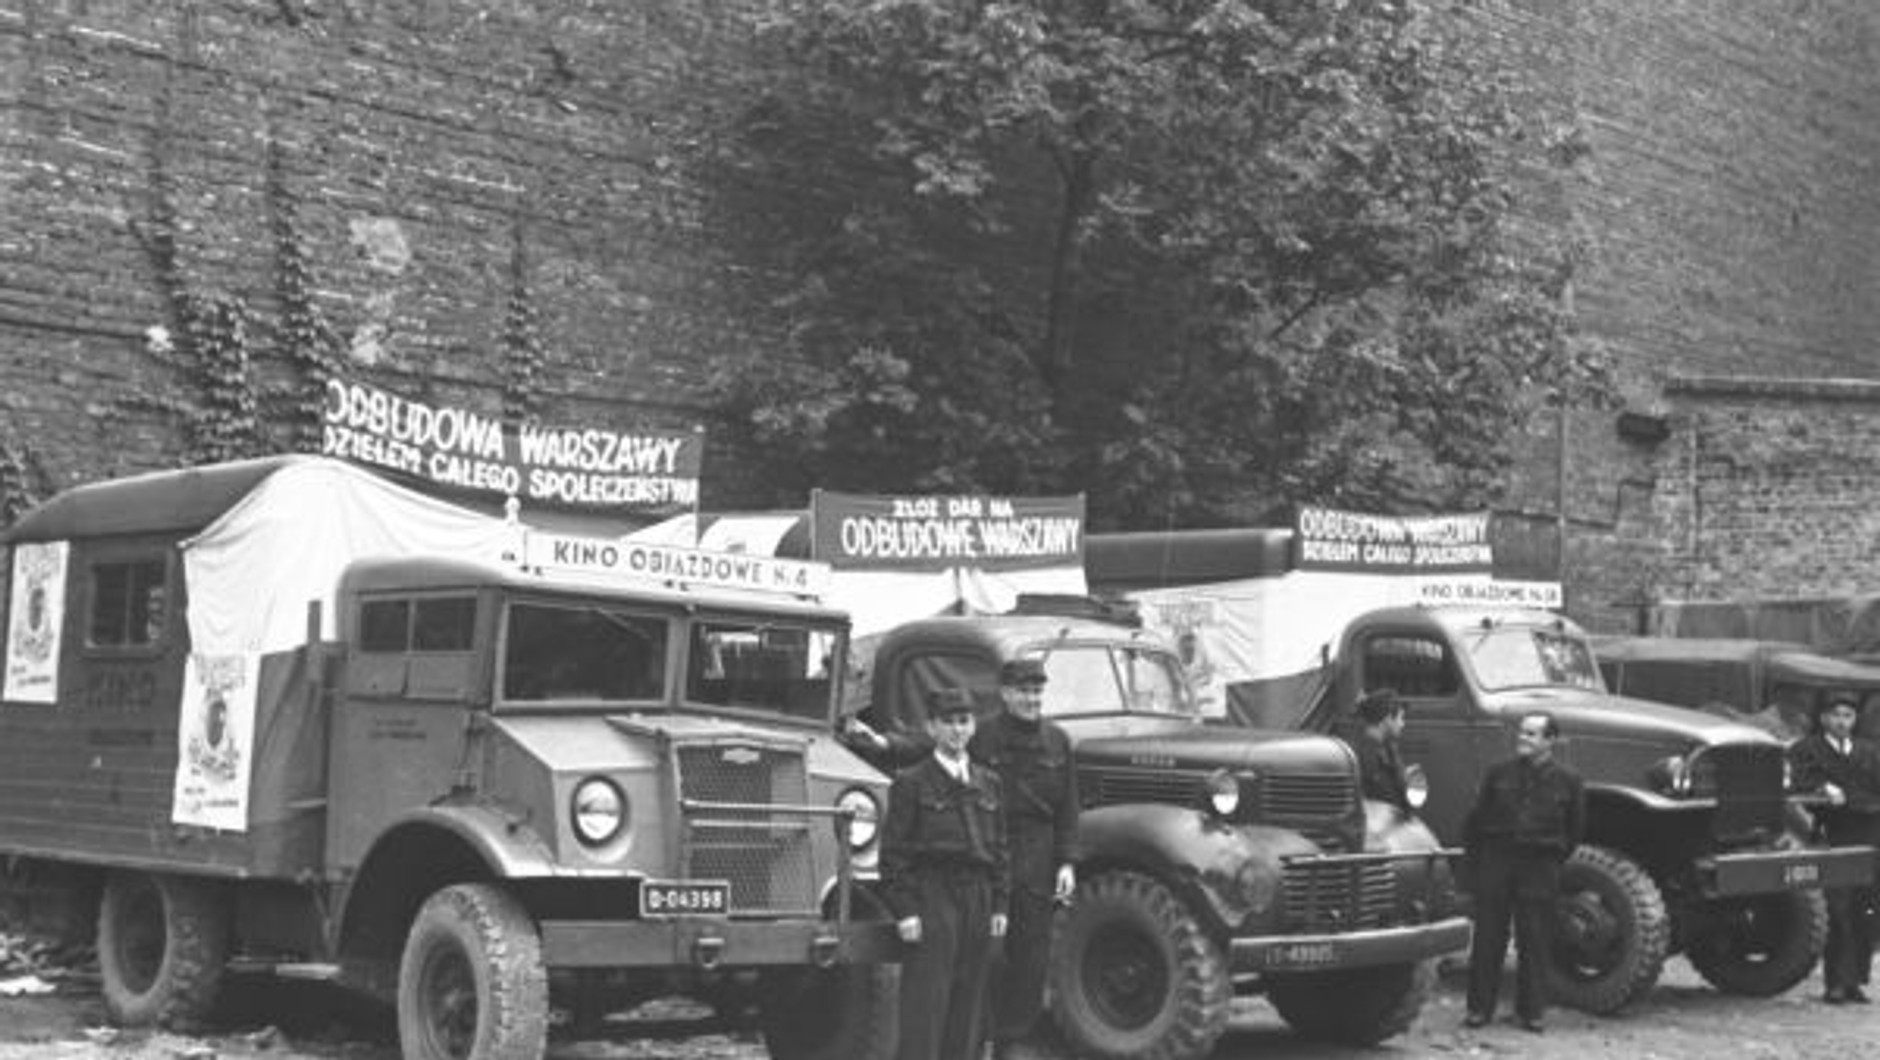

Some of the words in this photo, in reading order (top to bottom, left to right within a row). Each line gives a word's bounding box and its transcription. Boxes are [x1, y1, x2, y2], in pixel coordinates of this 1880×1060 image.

[520, 425, 681, 474] WARSZAWY
[948, 495, 983, 518] DAR
[989, 499, 1014, 518] NA
[979, 517, 1080, 556] WARSZAWY
[554, 540, 618, 567] KINO
